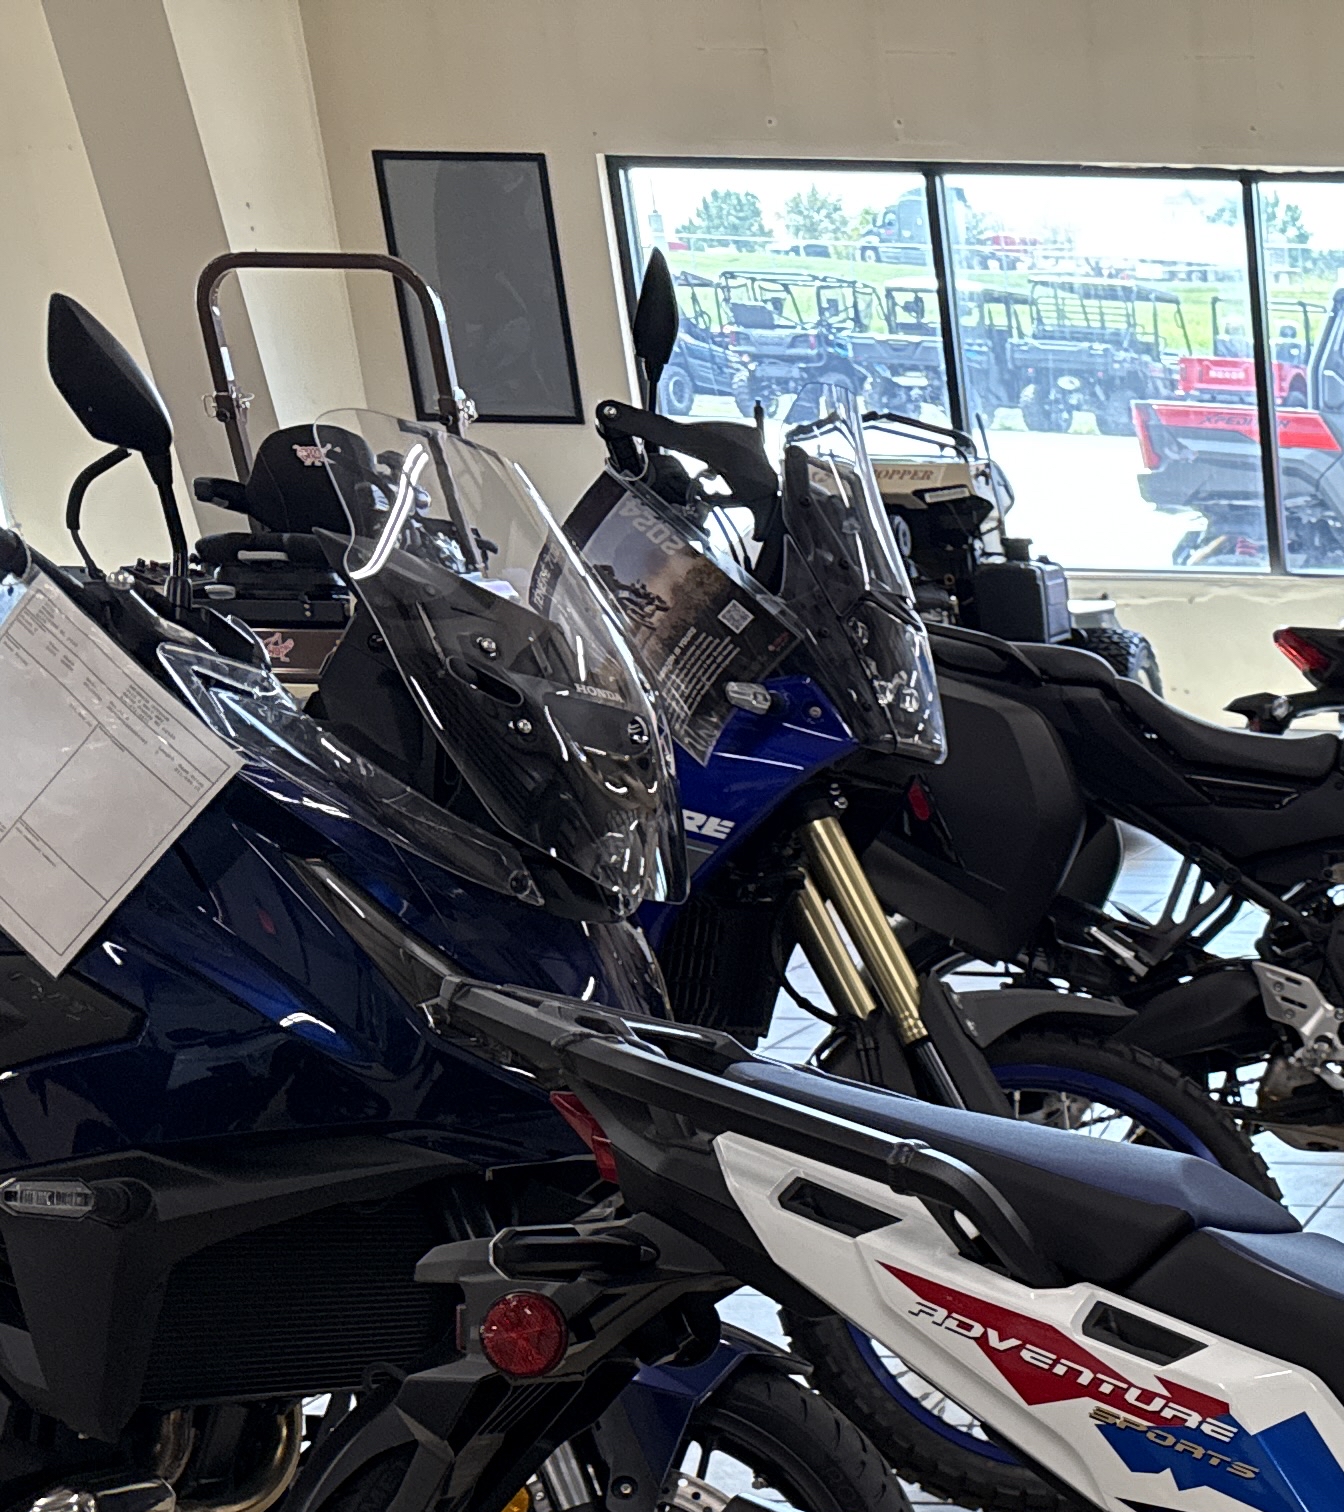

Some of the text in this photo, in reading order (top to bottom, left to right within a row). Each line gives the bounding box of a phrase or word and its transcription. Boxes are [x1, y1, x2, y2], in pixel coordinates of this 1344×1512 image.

[1201, 415, 1291, 428] XPEDIN
[874, 468, 934, 481] OPPER
[619, 500, 687, 556] 2024
[574, 683, 624, 704] HONDA
[682, 808, 736, 840] RE
[908, 1301, 1239, 1442] ADVENTURE
[1088, 1405, 1260, 1479] SPORTS
